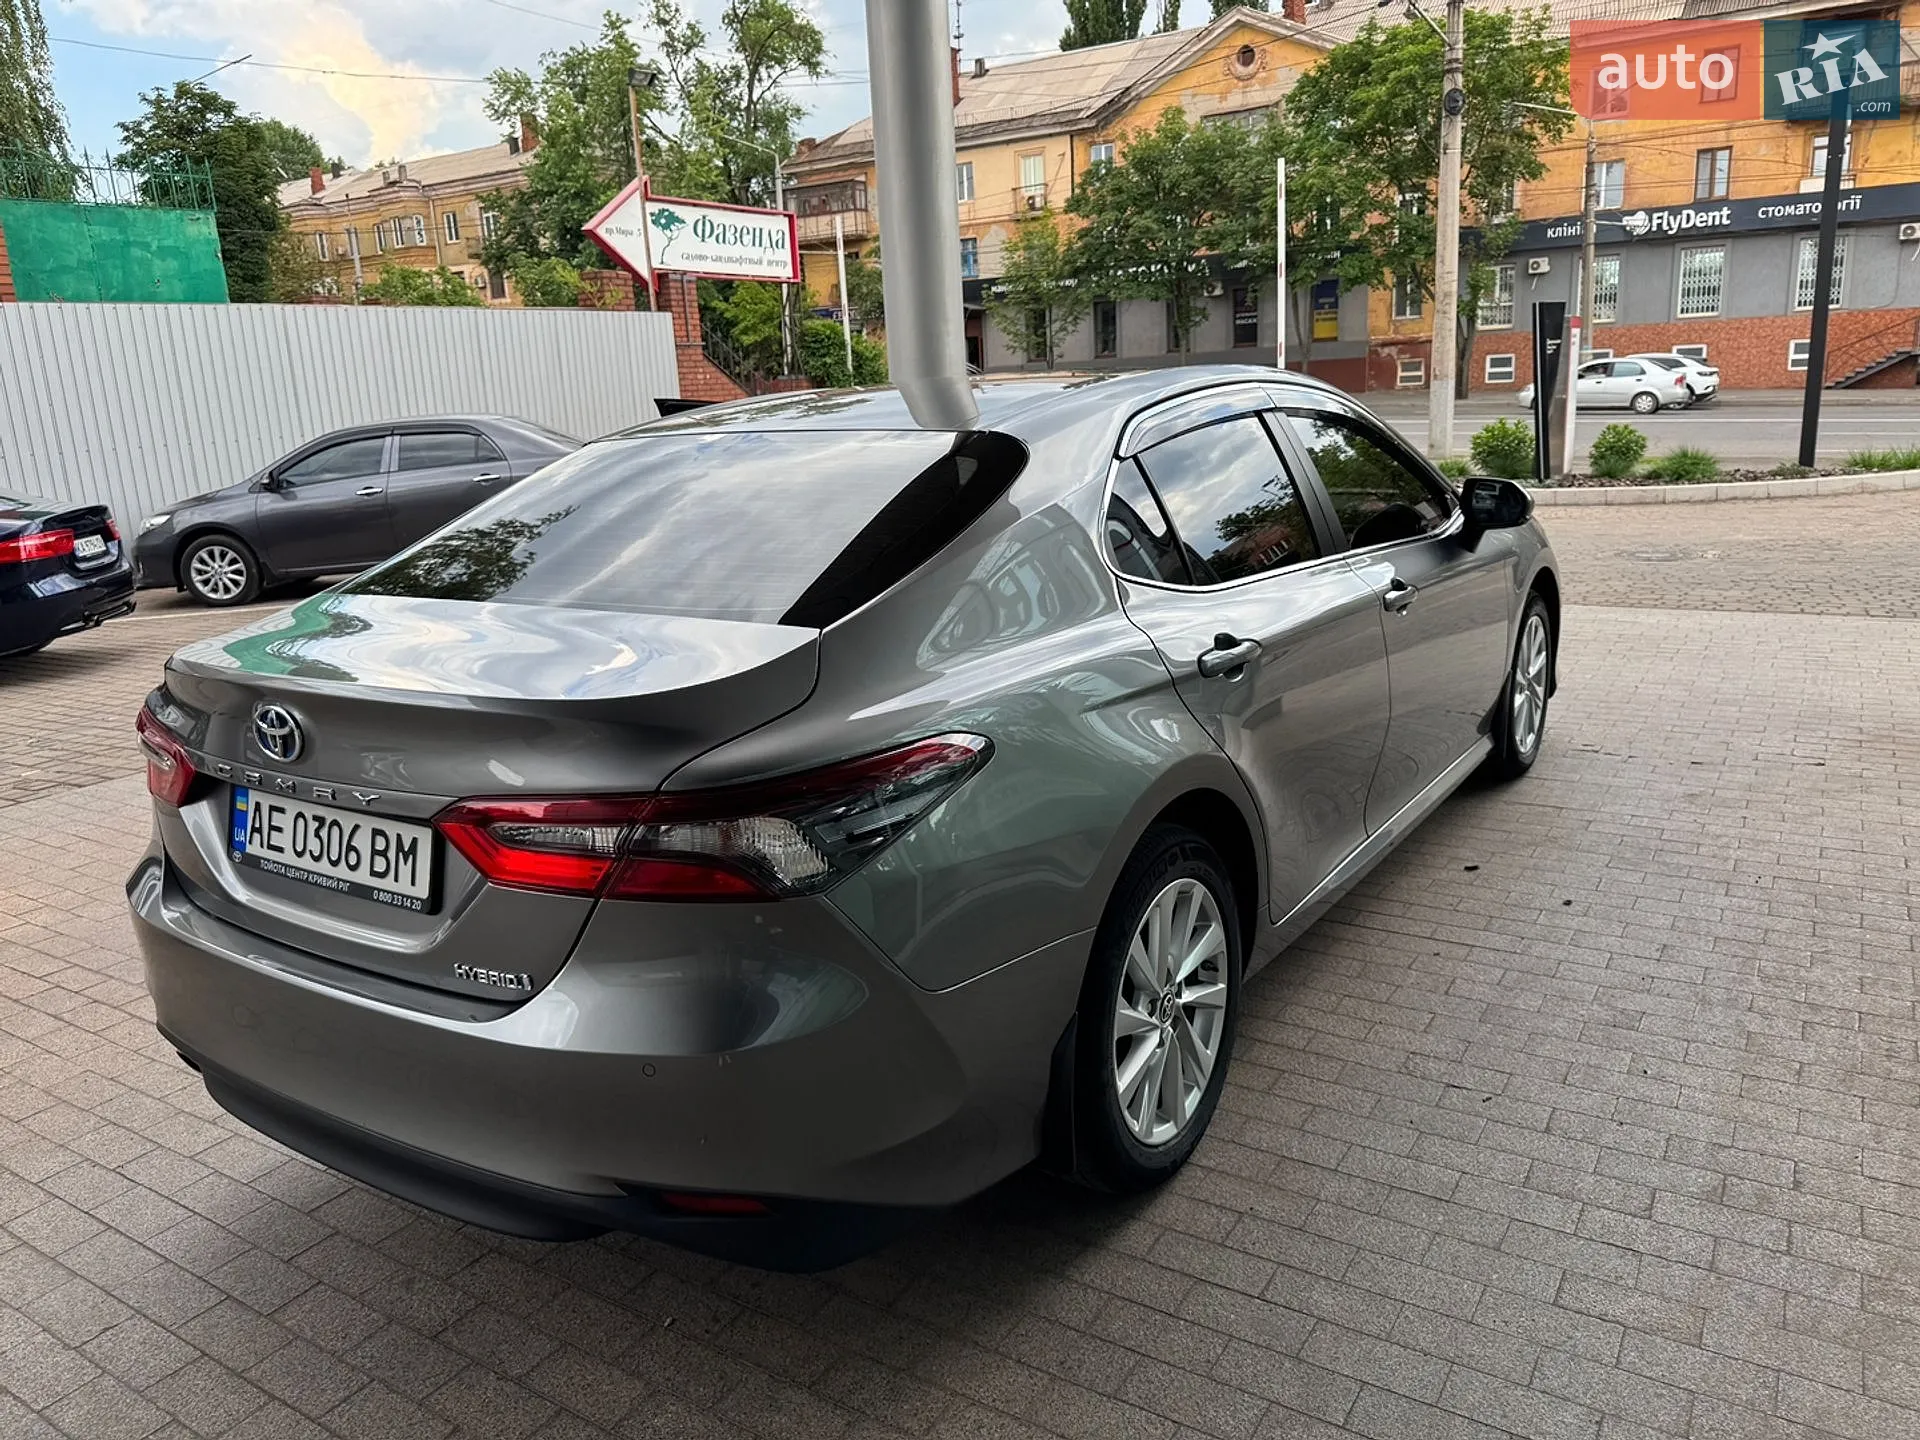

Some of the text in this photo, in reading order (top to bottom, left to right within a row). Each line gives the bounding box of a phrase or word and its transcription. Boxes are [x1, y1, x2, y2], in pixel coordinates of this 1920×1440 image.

[692, 214, 787, 255] Фазенда
[1547, 195, 1862, 239] кліні FlyDent стоматогії
[217, 763, 382, 807] CAMRY
[234, 827, 246, 843] UA
[248, 801, 419, 887] AE 0306 BM
[260, 858, 286, 875] ТОЙОТА
[286, 865, 308, 881] ЦЕНТР
[308, 870, 338, 889] КРИВИЙ
[373, 889, 378, 900] 0
[378, 890, 393, 903] 800
[393, 893, 402, 906] 33
[412, 899, 422, 911] 20
[454, 963, 518, 989] HYBRID
